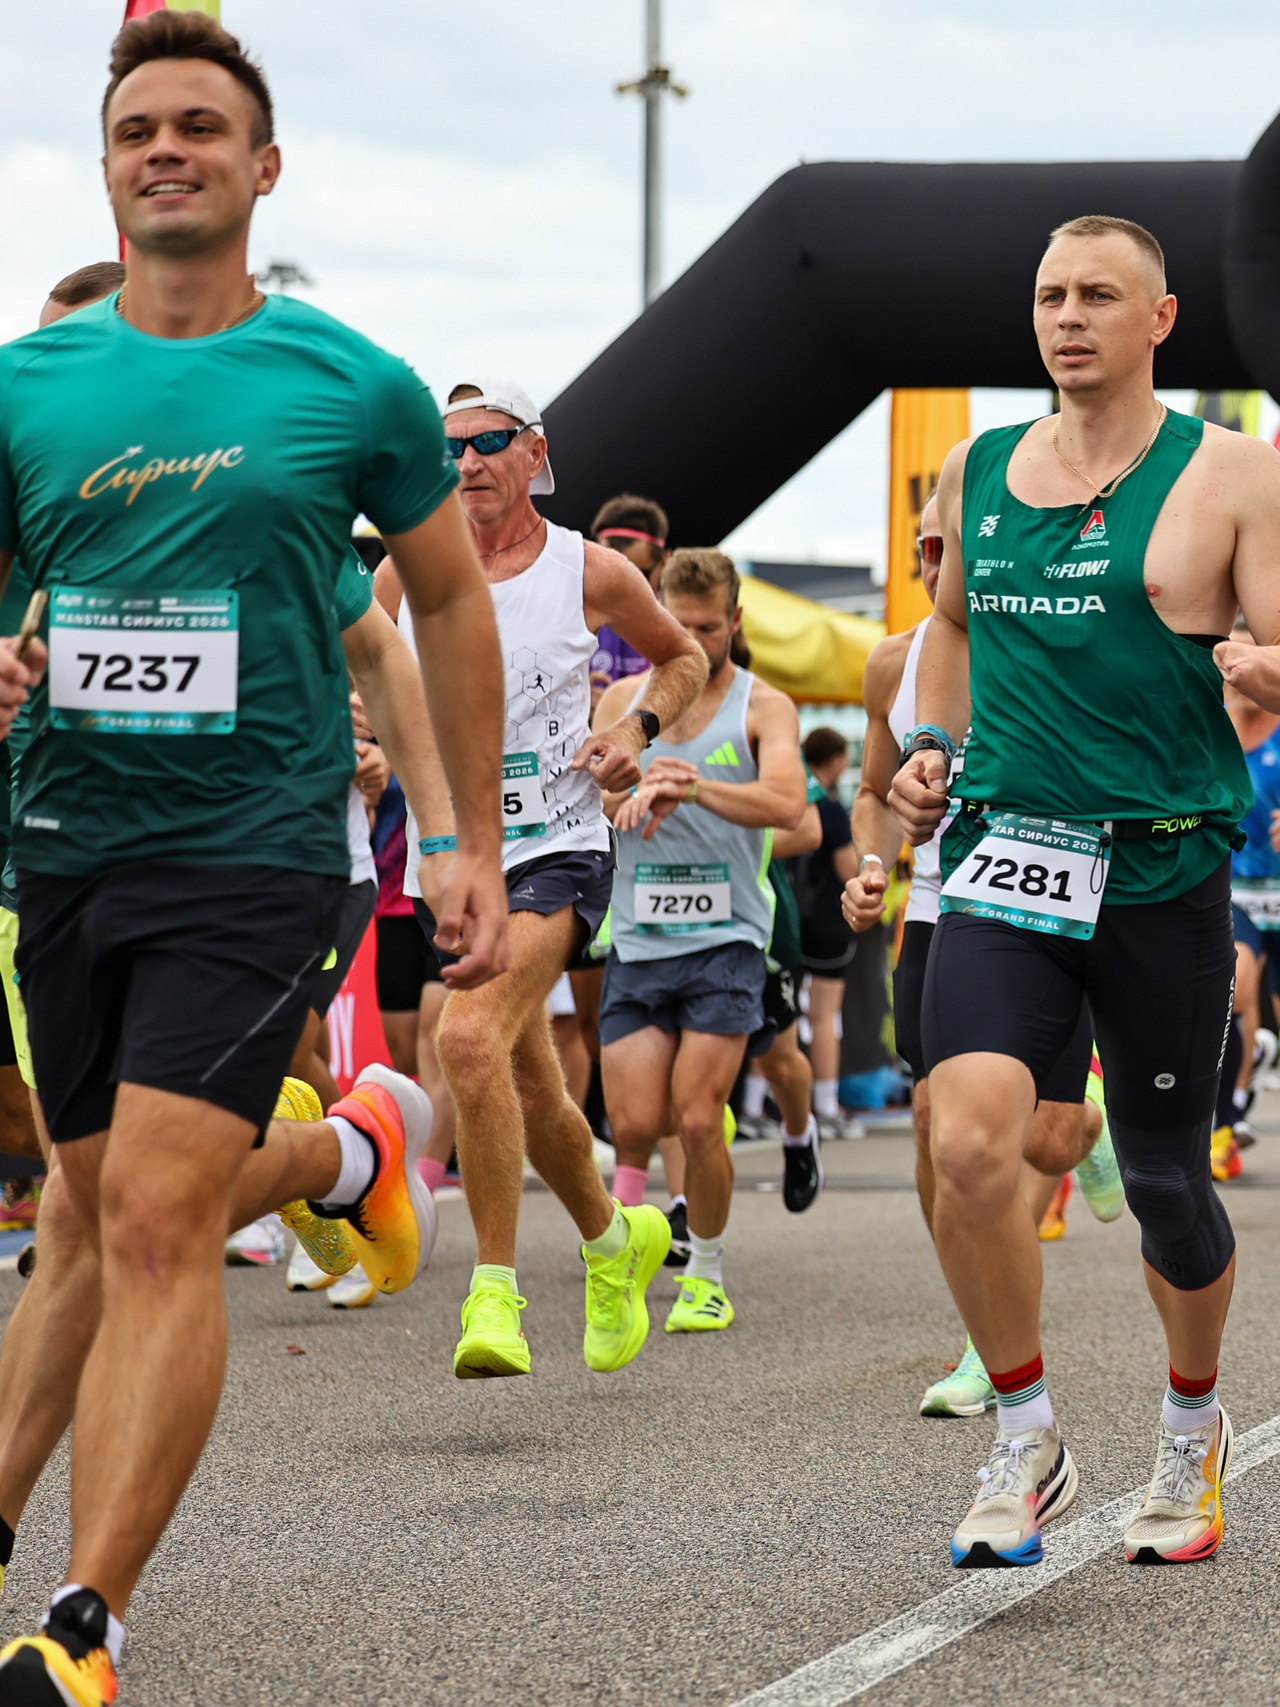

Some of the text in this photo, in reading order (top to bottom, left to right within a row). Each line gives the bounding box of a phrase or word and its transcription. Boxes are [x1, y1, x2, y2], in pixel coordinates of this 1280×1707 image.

[79, 445, 246, 507] Сириус
[1071, 540, 1109, 550] ЛОКОМОТИВ
[974, 568, 991, 577] CENTER
[967, 591, 1106, 615] ARMADA
[55, 613, 231, 628] MANSTAR СИРИУС 2026
[77, 653, 201, 694] 7237
[509, 767, 534, 777] 2026
[1018, 829, 1069, 847] СИРИУС
[968, 853, 1072, 903] 7281
[649, 895, 713, 914] 7270
[988, 909, 1060, 930] GRAND FINAL
[1216, 976, 1235, 1072] ARMADA
